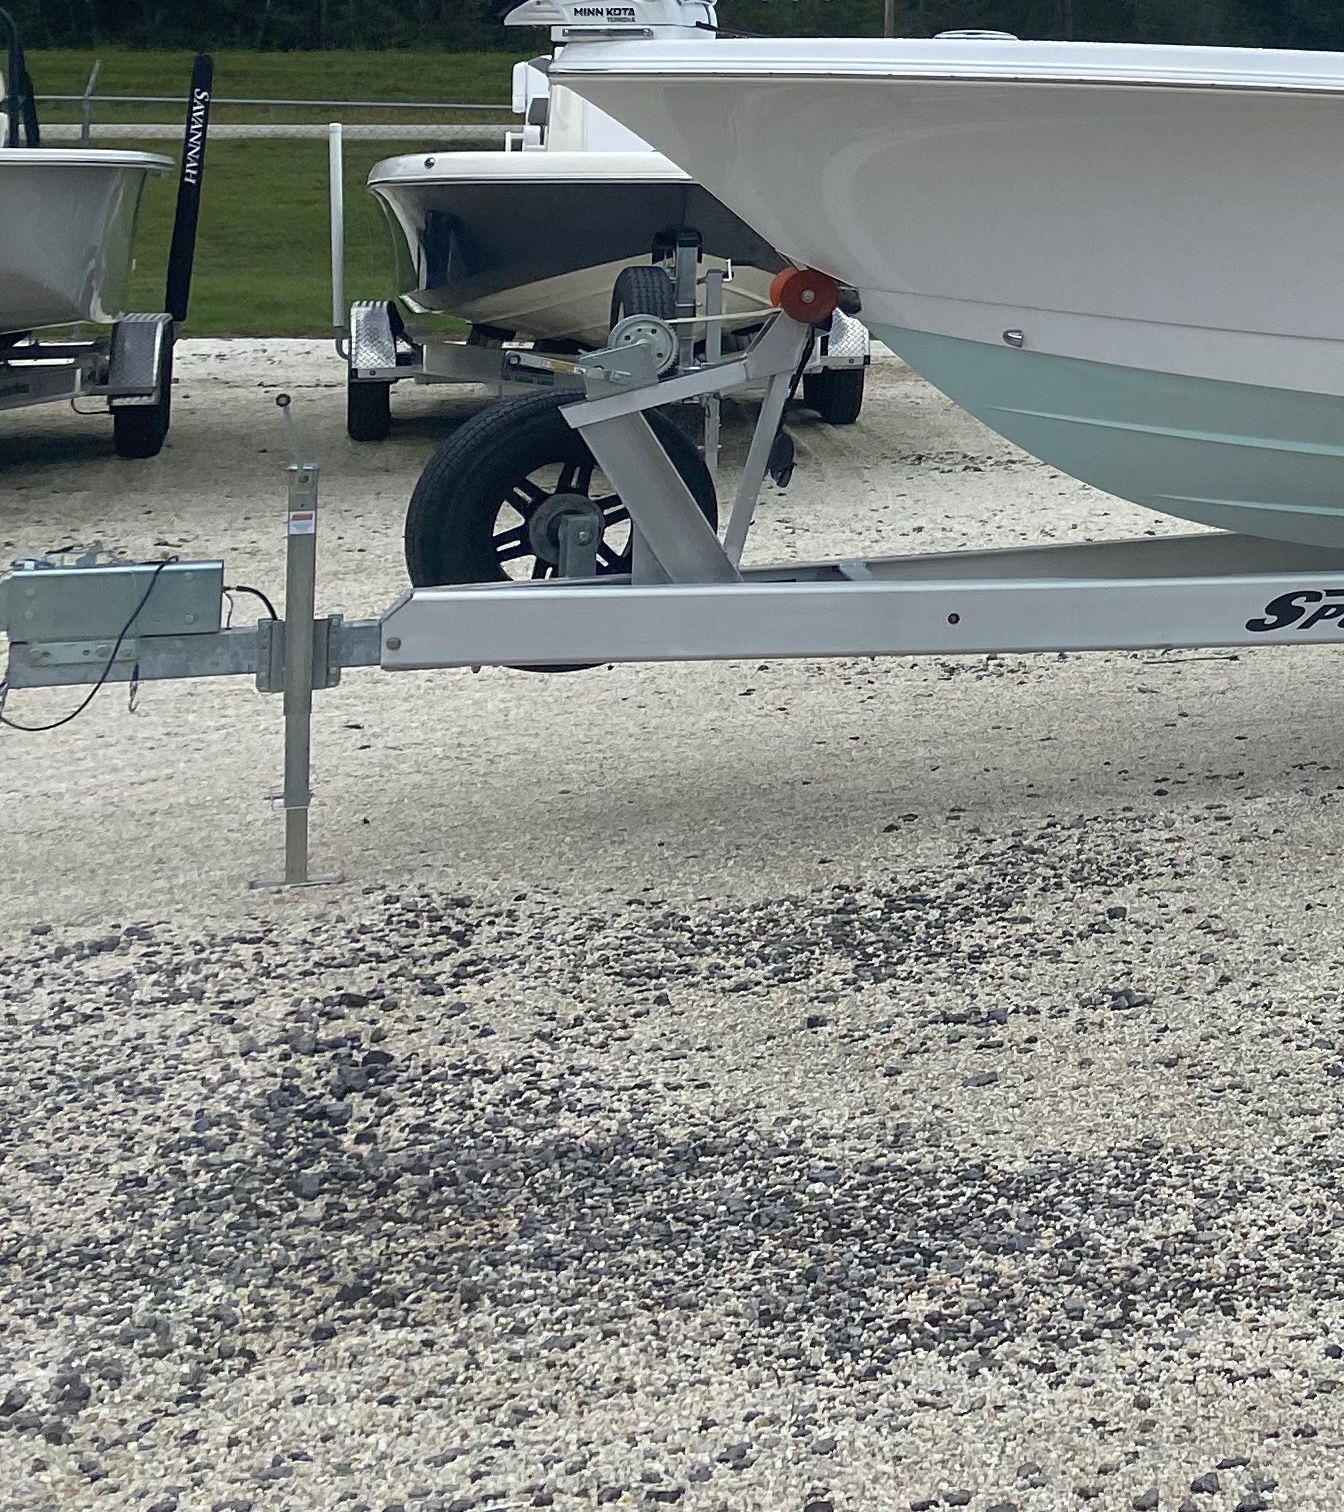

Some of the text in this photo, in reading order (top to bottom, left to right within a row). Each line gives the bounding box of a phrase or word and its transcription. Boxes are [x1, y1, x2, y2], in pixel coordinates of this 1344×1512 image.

[573, 7, 636, 17] MINN KOTA
[184, 88, 210, 184] SAVANNAH
